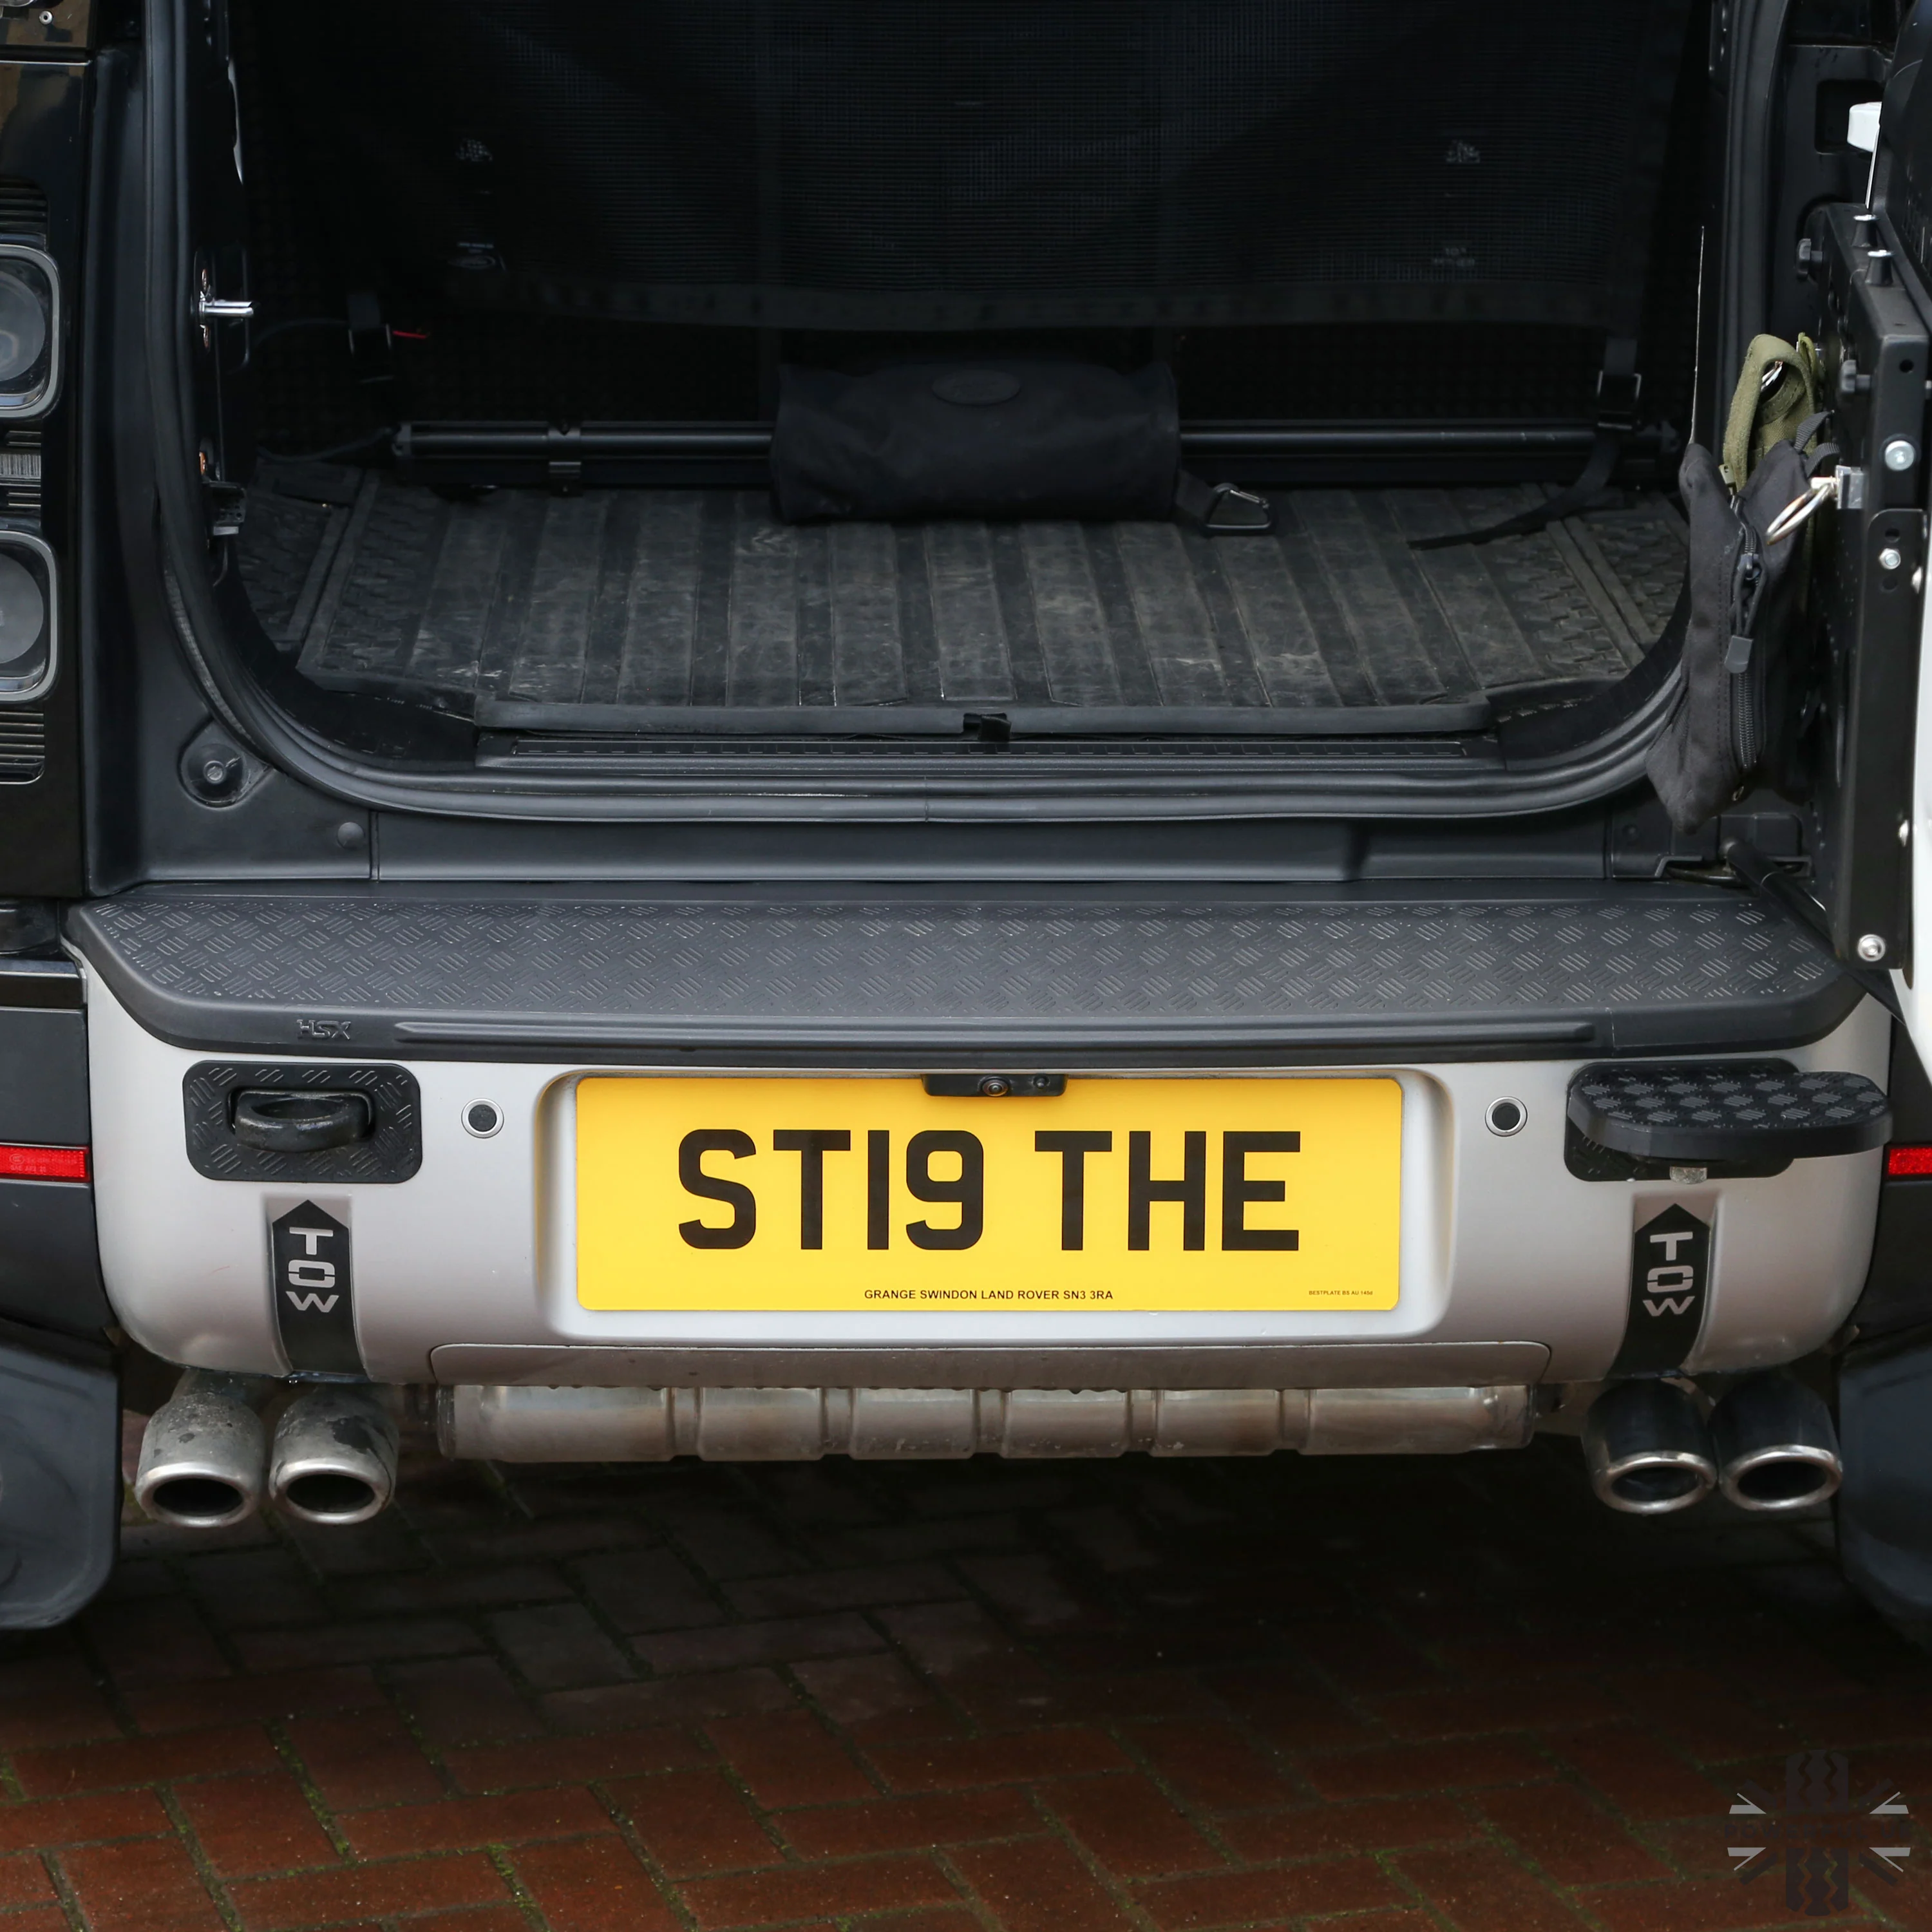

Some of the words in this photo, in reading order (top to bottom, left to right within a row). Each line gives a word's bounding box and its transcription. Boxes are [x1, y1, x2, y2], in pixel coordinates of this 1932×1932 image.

[1036, 1131, 1300, 1251] THE
[285, 1227, 339, 1312] TOW
[864, 1290, 916, 1299] GRANGE
[920, 1290, 977, 1299] SWINDON
[981, 1290, 1014, 1299] LAND
[1018, 1290, 1059, 1299] ROVER
[1063, 1290, 1086, 1299] SN3
[1090, 1290, 1113, 1299] 3RA
[1643, 1231, 1695, 1316] TOW
